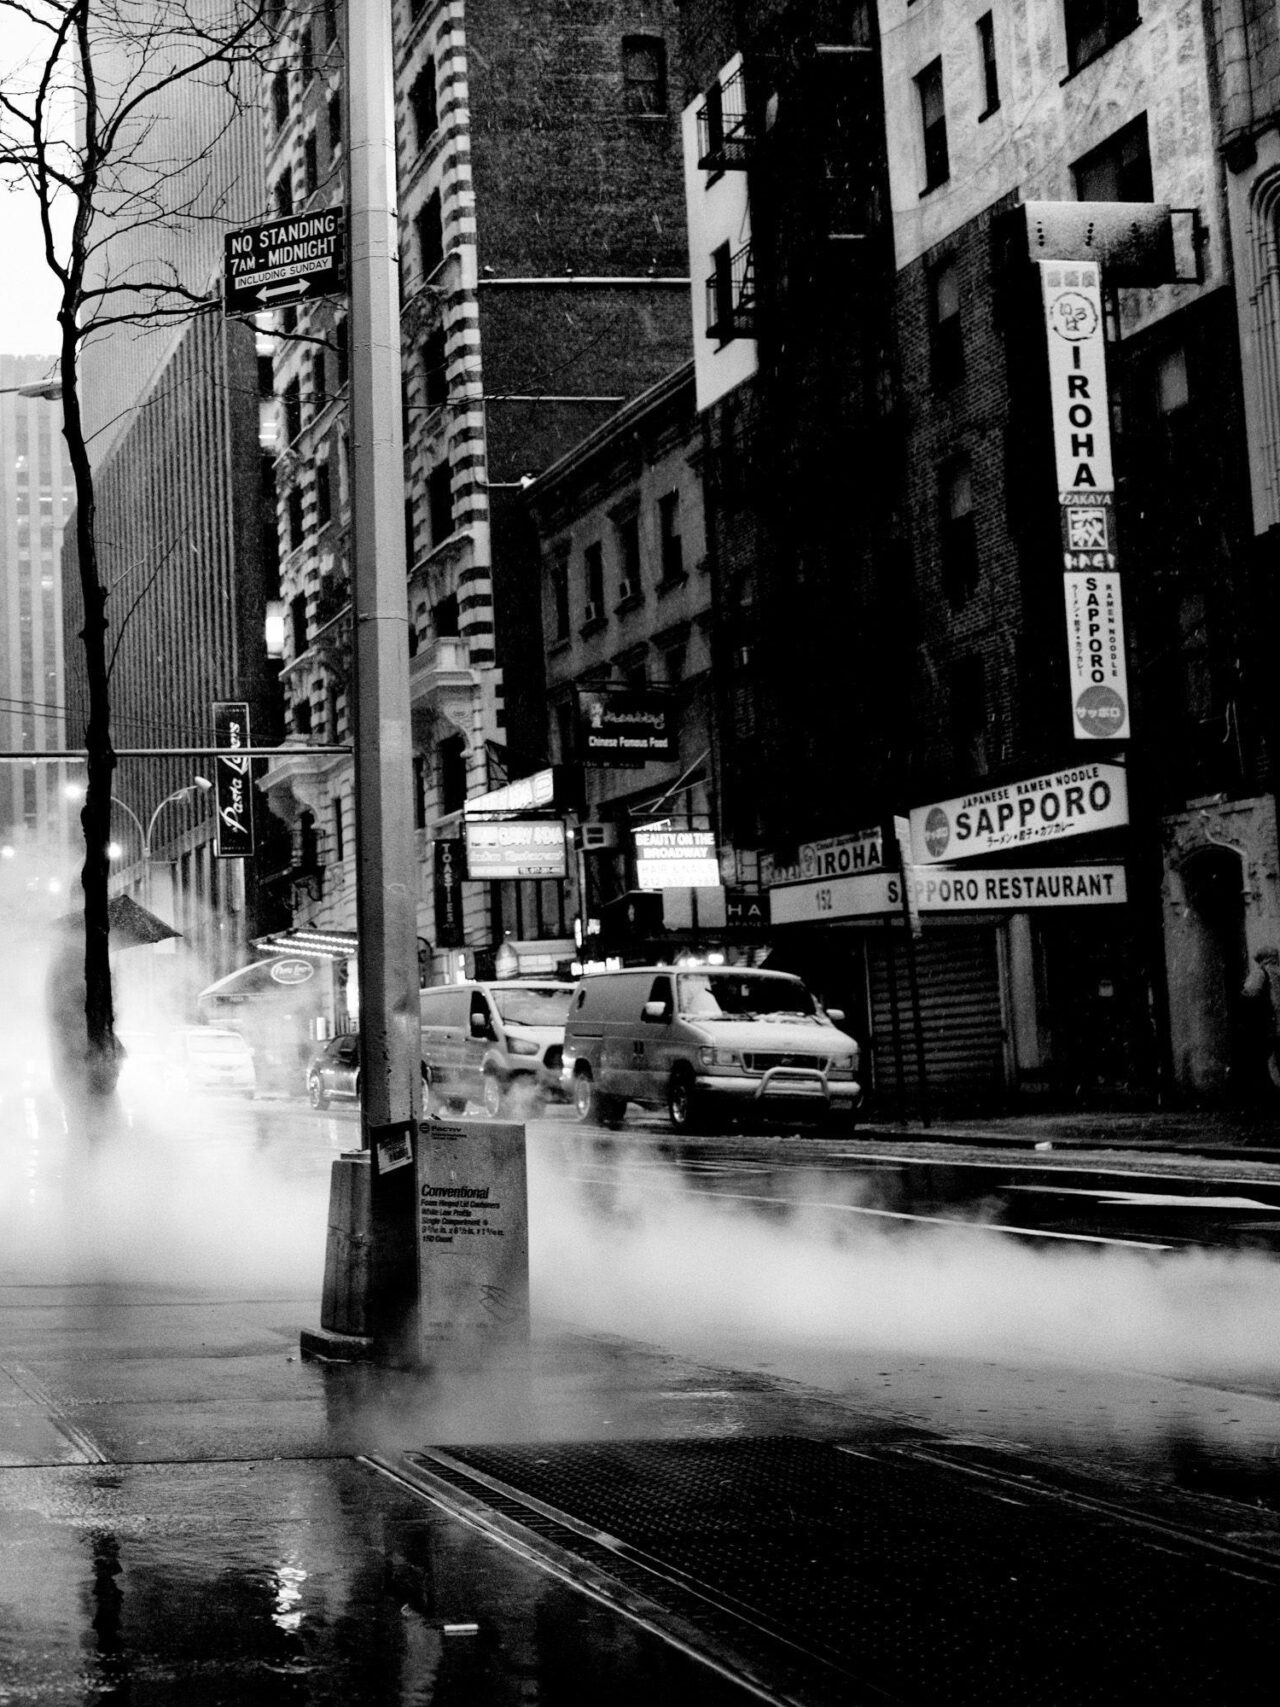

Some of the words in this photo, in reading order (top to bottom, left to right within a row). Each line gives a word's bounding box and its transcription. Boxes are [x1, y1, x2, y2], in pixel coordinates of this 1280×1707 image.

[232, 235, 253, 255] NO
[259, 215, 335, 248] STANDING
[230, 256, 255, 275] 7AM
[268, 236, 337, 267] MIDNIGHT
[237, 268, 286, 286] INCLUDING
[290, 258, 329, 276] SUNDAY
[1067, 345, 1097, 487] IROHA
[1106, 583, 1116, 624] RAMEN
[1085, 577, 1105, 684] SAPPORO
[1108, 628, 1119, 678] NOODLE
[219, 778, 249, 834] Pasta
[962, 788, 1010, 810] JAPANESE
[1017, 778, 1052, 796] RAMEN
[1055, 766, 1099, 788] NOODLE
[955, 780, 1112, 841] SAPPORO
[635, 832, 677, 846] BEAUTY
[677, 832, 694, 846] ON
[694, 832, 715, 846] THE
[643, 847, 708, 859] BROADWAY
[817, 841, 880, 876] IROHA
[441, 843, 454, 923] TOASTIES
[816, 888, 832, 911] 152
[888, 878, 979, 903] SPPORO
[985, 873, 1114, 900] RESTAURANT
[422, 1184, 489, 1199] Conventional
